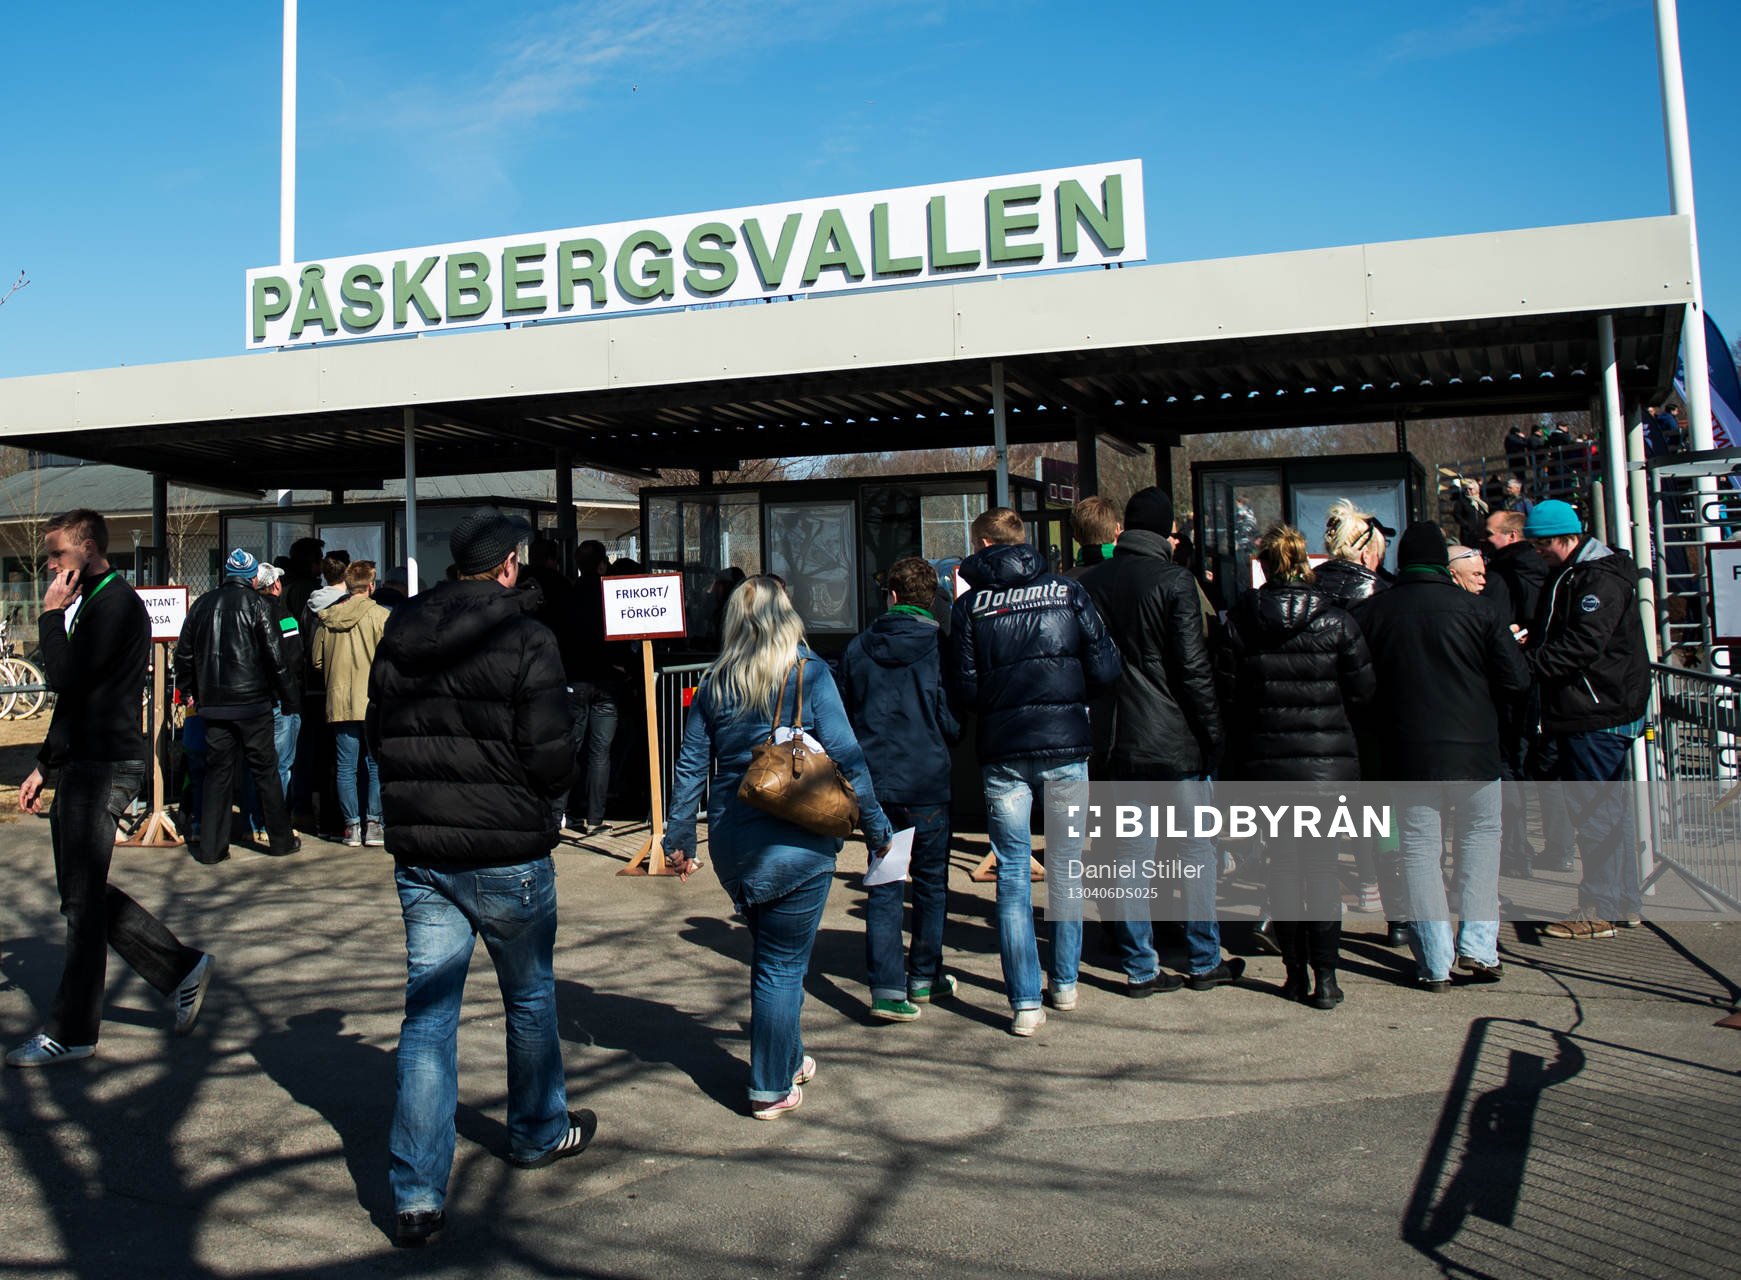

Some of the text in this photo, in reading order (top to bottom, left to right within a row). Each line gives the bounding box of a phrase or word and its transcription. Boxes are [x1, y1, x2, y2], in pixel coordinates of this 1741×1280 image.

[253, 174, 1125, 341] PÅSKBERGSVALLEN
[615, 585, 669, 600] FRIKORT/
[972, 580, 1068, 613] Dolomite
[145, 597, 180, 607] NTANT-
[620, 604, 667, 619] FÖRKÖP
[149, 615, 171, 625] ASSA
